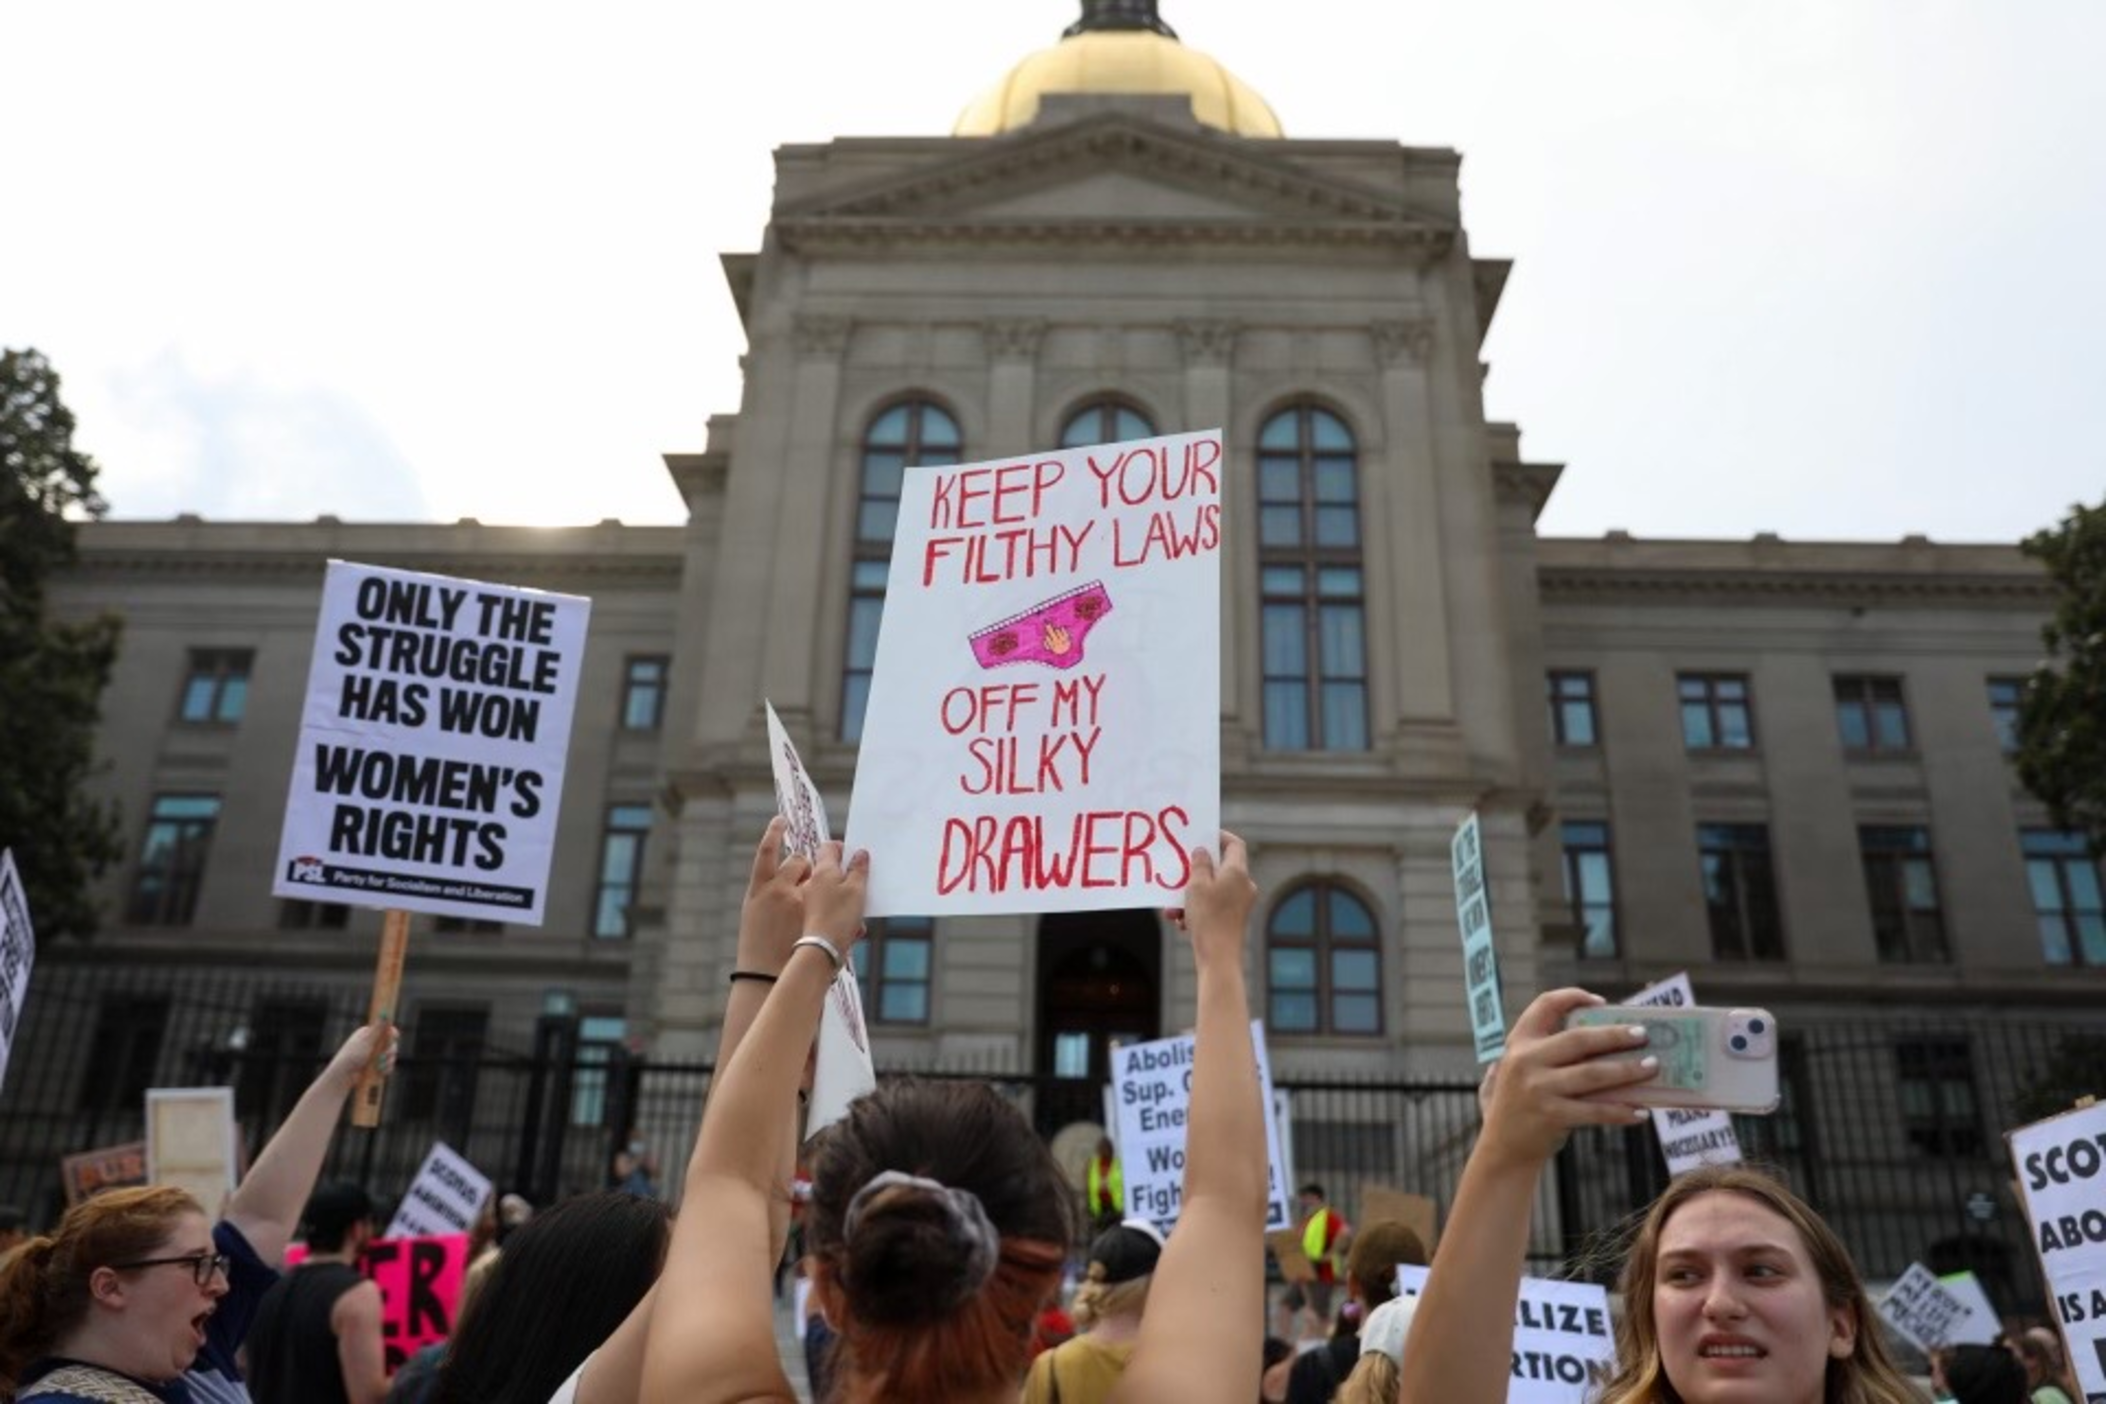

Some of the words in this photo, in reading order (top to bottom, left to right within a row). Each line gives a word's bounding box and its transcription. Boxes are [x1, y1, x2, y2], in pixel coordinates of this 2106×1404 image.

[930, 460, 1065, 530] KEEP
[1087, 439, 1221, 508] YOUR
[923, 519, 1095, 587] FILTHY
[1112, 504, 1221, 567] LAWS
[356, 576, 468, 631] ONLY
[476, 593, 556, 645] THE
[334, 622, 561, 694] STRUGGLE
[338, 675, 429, 728] HAS
[440, 687, 540, 743] WON
[941, 684, 1039, 735] OFF
[1051, 674, 1107, 727] MY
[315, 743, 543, 819] WOMEN'S
[960, 727, 1101, 795] SILKY
[329, 804, 507, 871] RIGHTS
[937, 806, 1192, 895] DRAWERS
[292, 863, 327, 884] PSL
[332, 871, 366, 888] Party
[367, 872, 385, 885] for
[387, 877, 442, 895] Socialism
[443, 884, 466, 897] and
[467, 886, 525, 905] Liberation
[1126, 1042, 1195, 1074] Abolis
[1122, 1080, 1175, 1105] Sup.
[1131, 1181, 1182, 1216] Figh
[2039, 1208, 2106, 1254] ABO
[365, 1242, 451, 1338] ER
[1514, 1299, 1607, 1337] LIZE
[2057, 1293, 2086, 1324] IS
